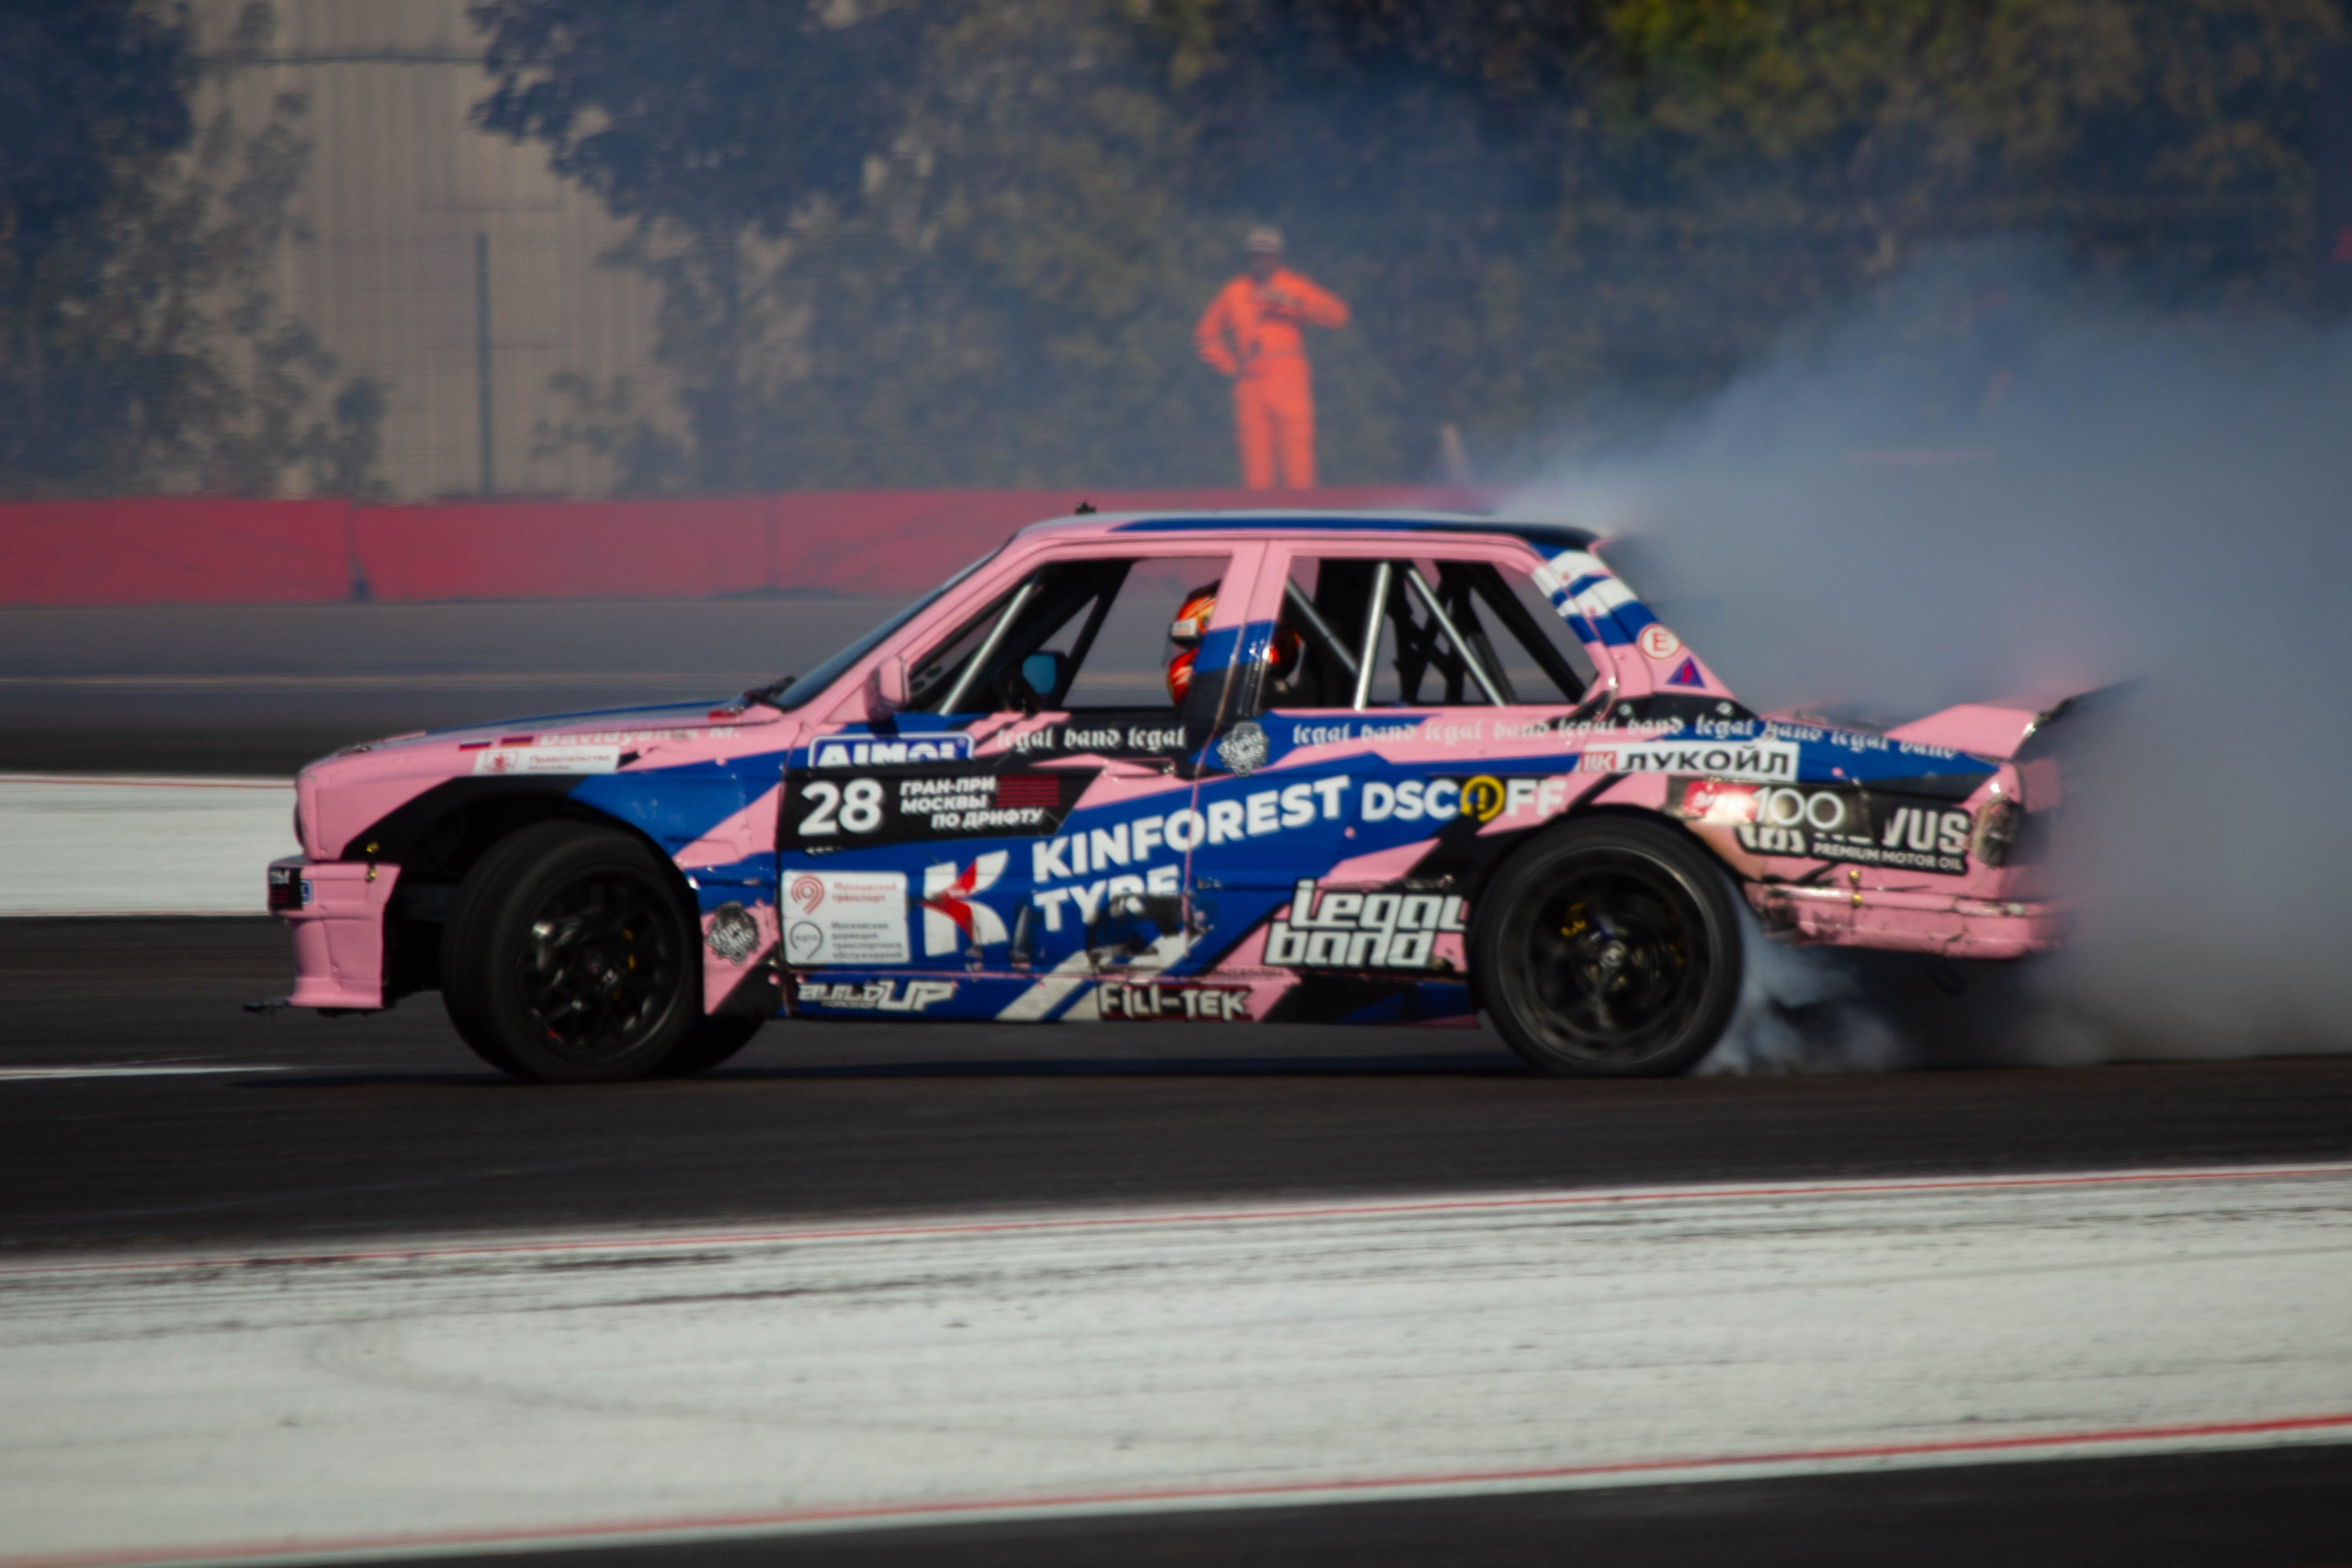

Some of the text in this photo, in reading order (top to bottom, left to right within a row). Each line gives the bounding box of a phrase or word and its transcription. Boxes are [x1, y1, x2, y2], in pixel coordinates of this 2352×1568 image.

[1621, 746, 1790, 774] ЛУКОЙЛ
[899, 776, 998, 796] ГРАН-ПРИ
[797, 778, 883, 836] 28
[900, 794, 990, 814] МОСКВЫ
[932, 807, 1045, 829] ПО ДРИФТУ
[1752, 787, 1845, 828] 100
[1032, 775, 1350, 885] KINFOREST
[1813, 841, 1964, 871] PREMIUM MOTOR OIL
[1033, 864, 1180, 931] TYRE
